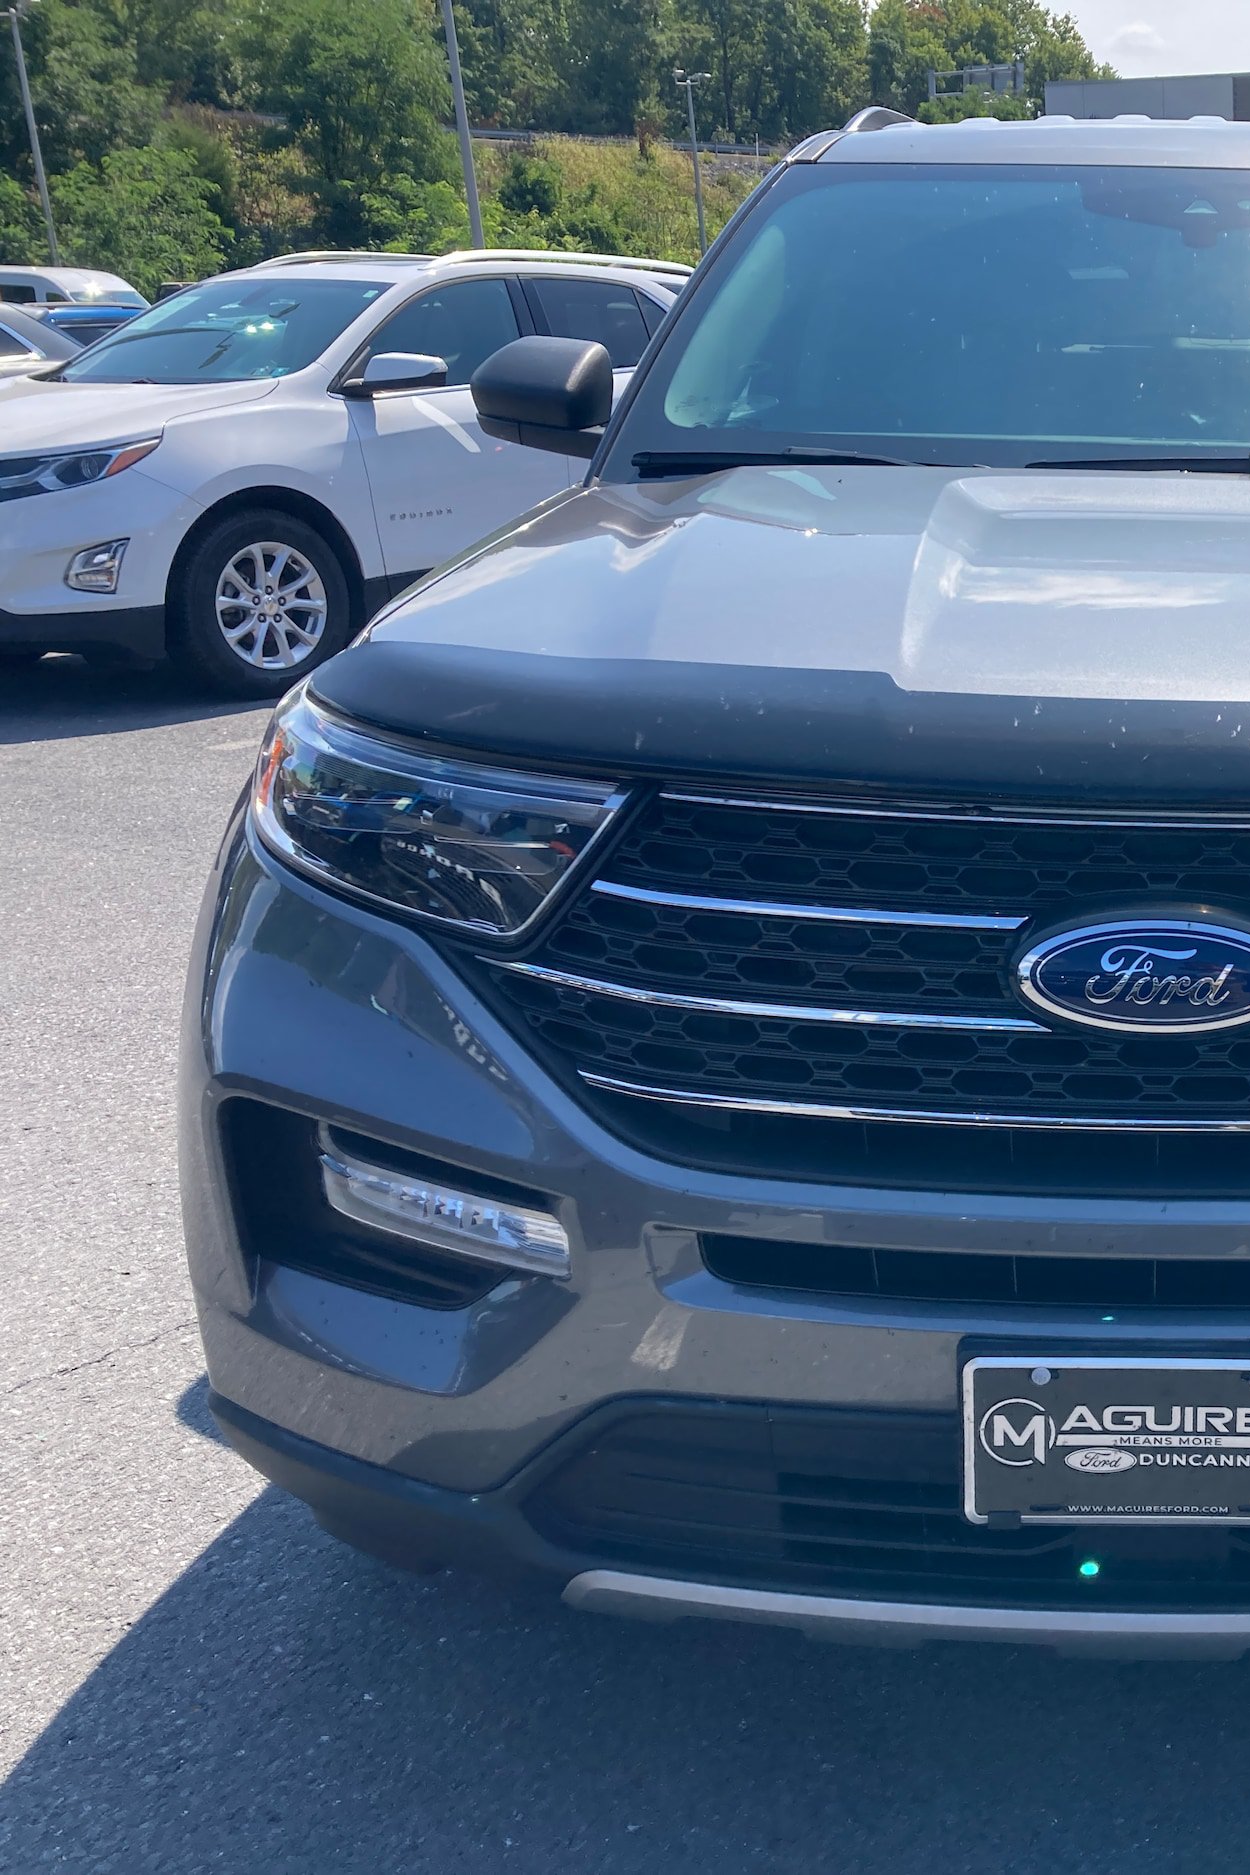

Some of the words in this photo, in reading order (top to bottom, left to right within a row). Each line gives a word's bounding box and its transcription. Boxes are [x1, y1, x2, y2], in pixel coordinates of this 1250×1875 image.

[1084, 944, 1235, 1007] Ford
[1119, 1435, 1173, 1447] MEANS
[1178, 1436, 1223, 1447] MORE
[1079, 1450, 1123, 1469] Ford
[1067, 1505, 1229, 1514] WWW.MAGUIRESFORD.COM
